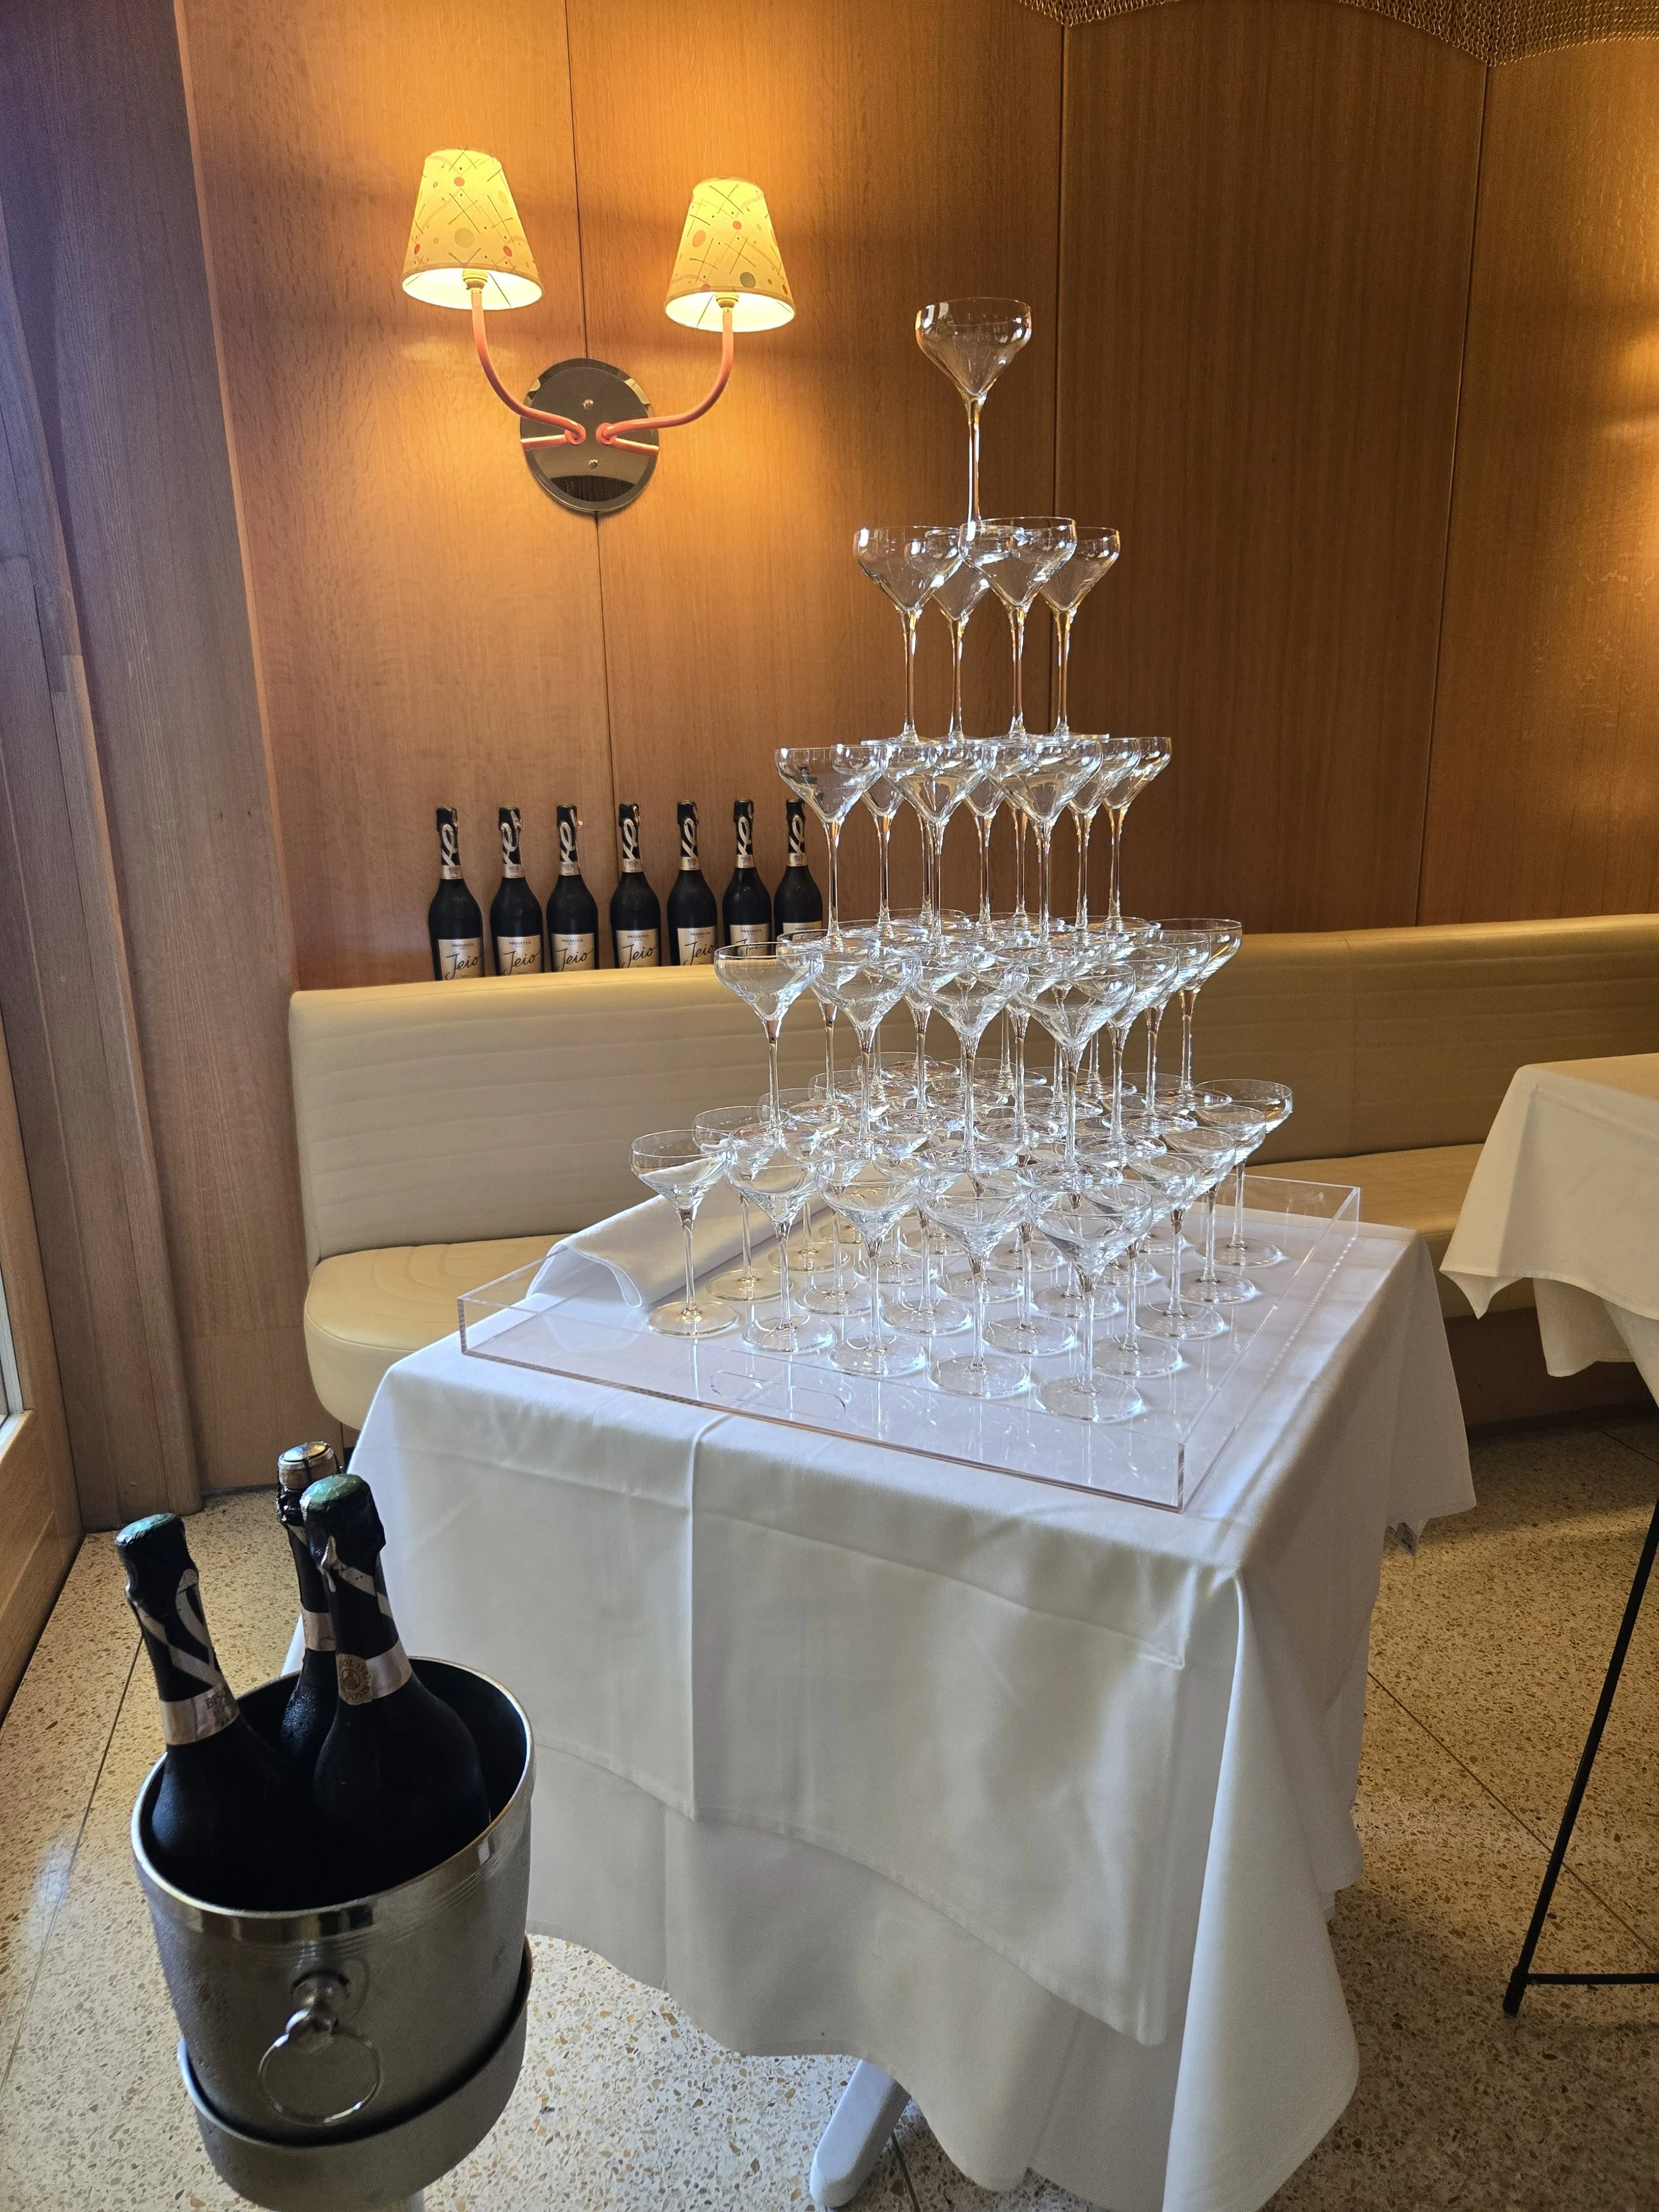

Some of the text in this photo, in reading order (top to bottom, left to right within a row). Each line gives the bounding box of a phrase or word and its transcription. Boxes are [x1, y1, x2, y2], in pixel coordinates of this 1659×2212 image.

[503, 950, 542, 976] Jeio
[556, 948, 595, 972] Jeio
[622, 944, 658, 968] Jeio
[683, 940, 715, 966] Jeio
[445, 953, 482, 981] Jeio
